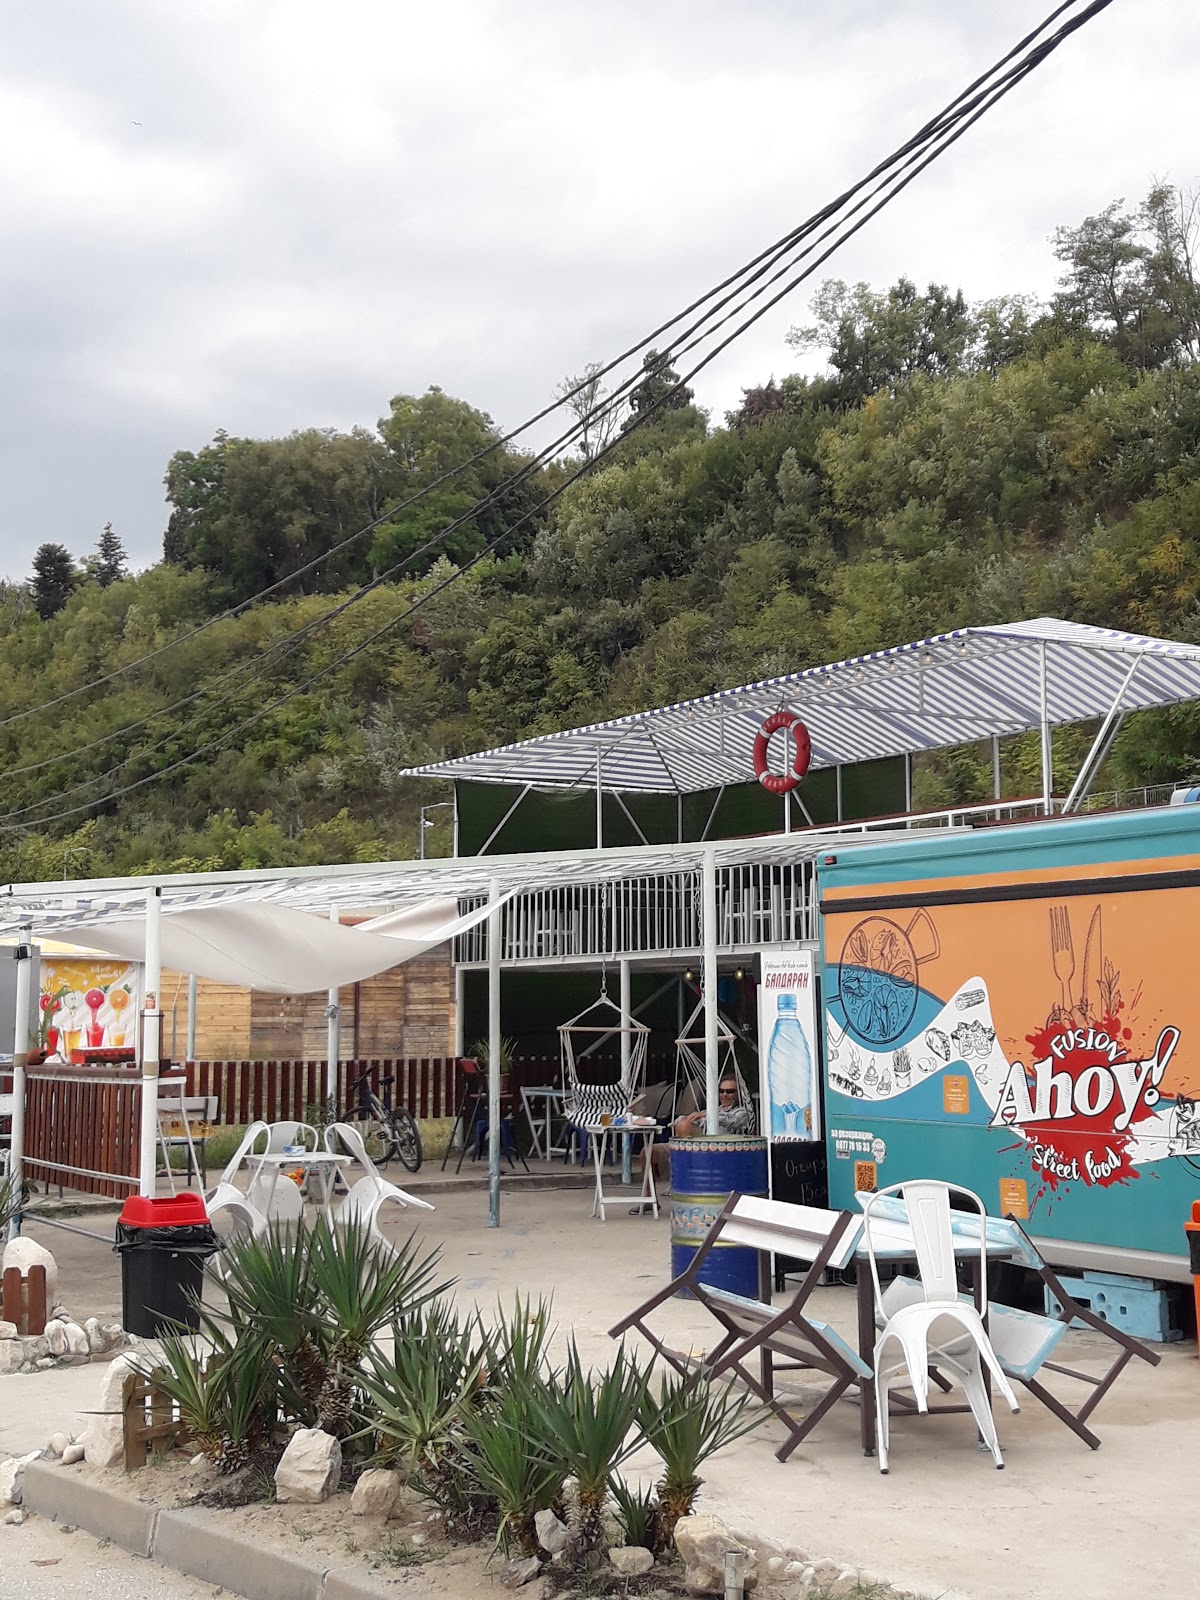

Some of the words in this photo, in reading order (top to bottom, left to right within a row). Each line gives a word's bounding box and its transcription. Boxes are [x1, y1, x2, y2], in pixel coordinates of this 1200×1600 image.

[765, 972, 809, 989] БАЛДАРАН
[1050, 1028, 1128, 1062] FUSION
[989, 1025, 1182, 1132] Ahoy!
[1032, 1144, 1080, 1181] Street
